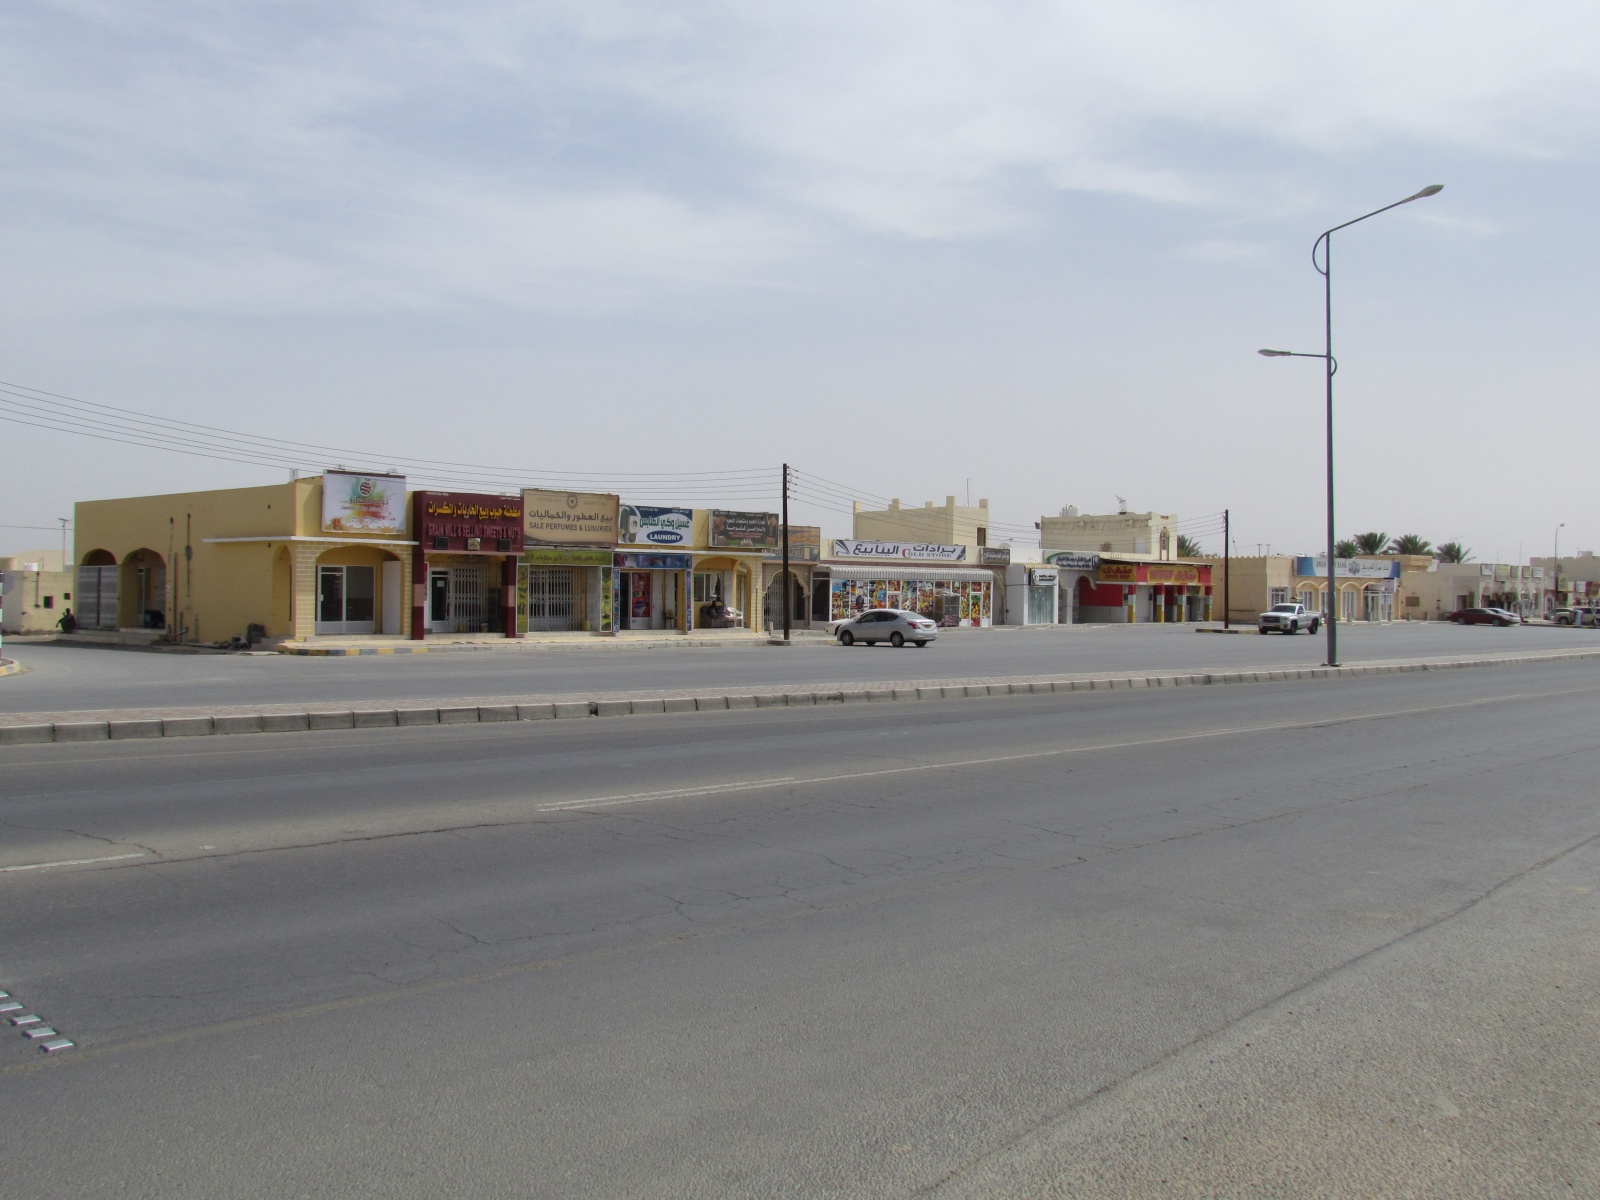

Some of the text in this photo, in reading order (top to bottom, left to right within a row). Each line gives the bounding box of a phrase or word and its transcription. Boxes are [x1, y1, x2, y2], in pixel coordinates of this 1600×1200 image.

[529, 509, 613, 524] بيع العطور والكماليات
[428, 523, 444, 536] GRAIN
[444, 524, 457, 537] MILL
[462, 524, 483, 538] SELLING
[483, 525, 502, 538] SWEETS
[507, 526, 521, 539] NUTS
[545, 522, 577, 531] PERFUMES
[650, 533, 681, 541] LAUNDRY
[853, 543, 956, 556] برادات الينابيع
[901, 548, 925, 558] COLD
